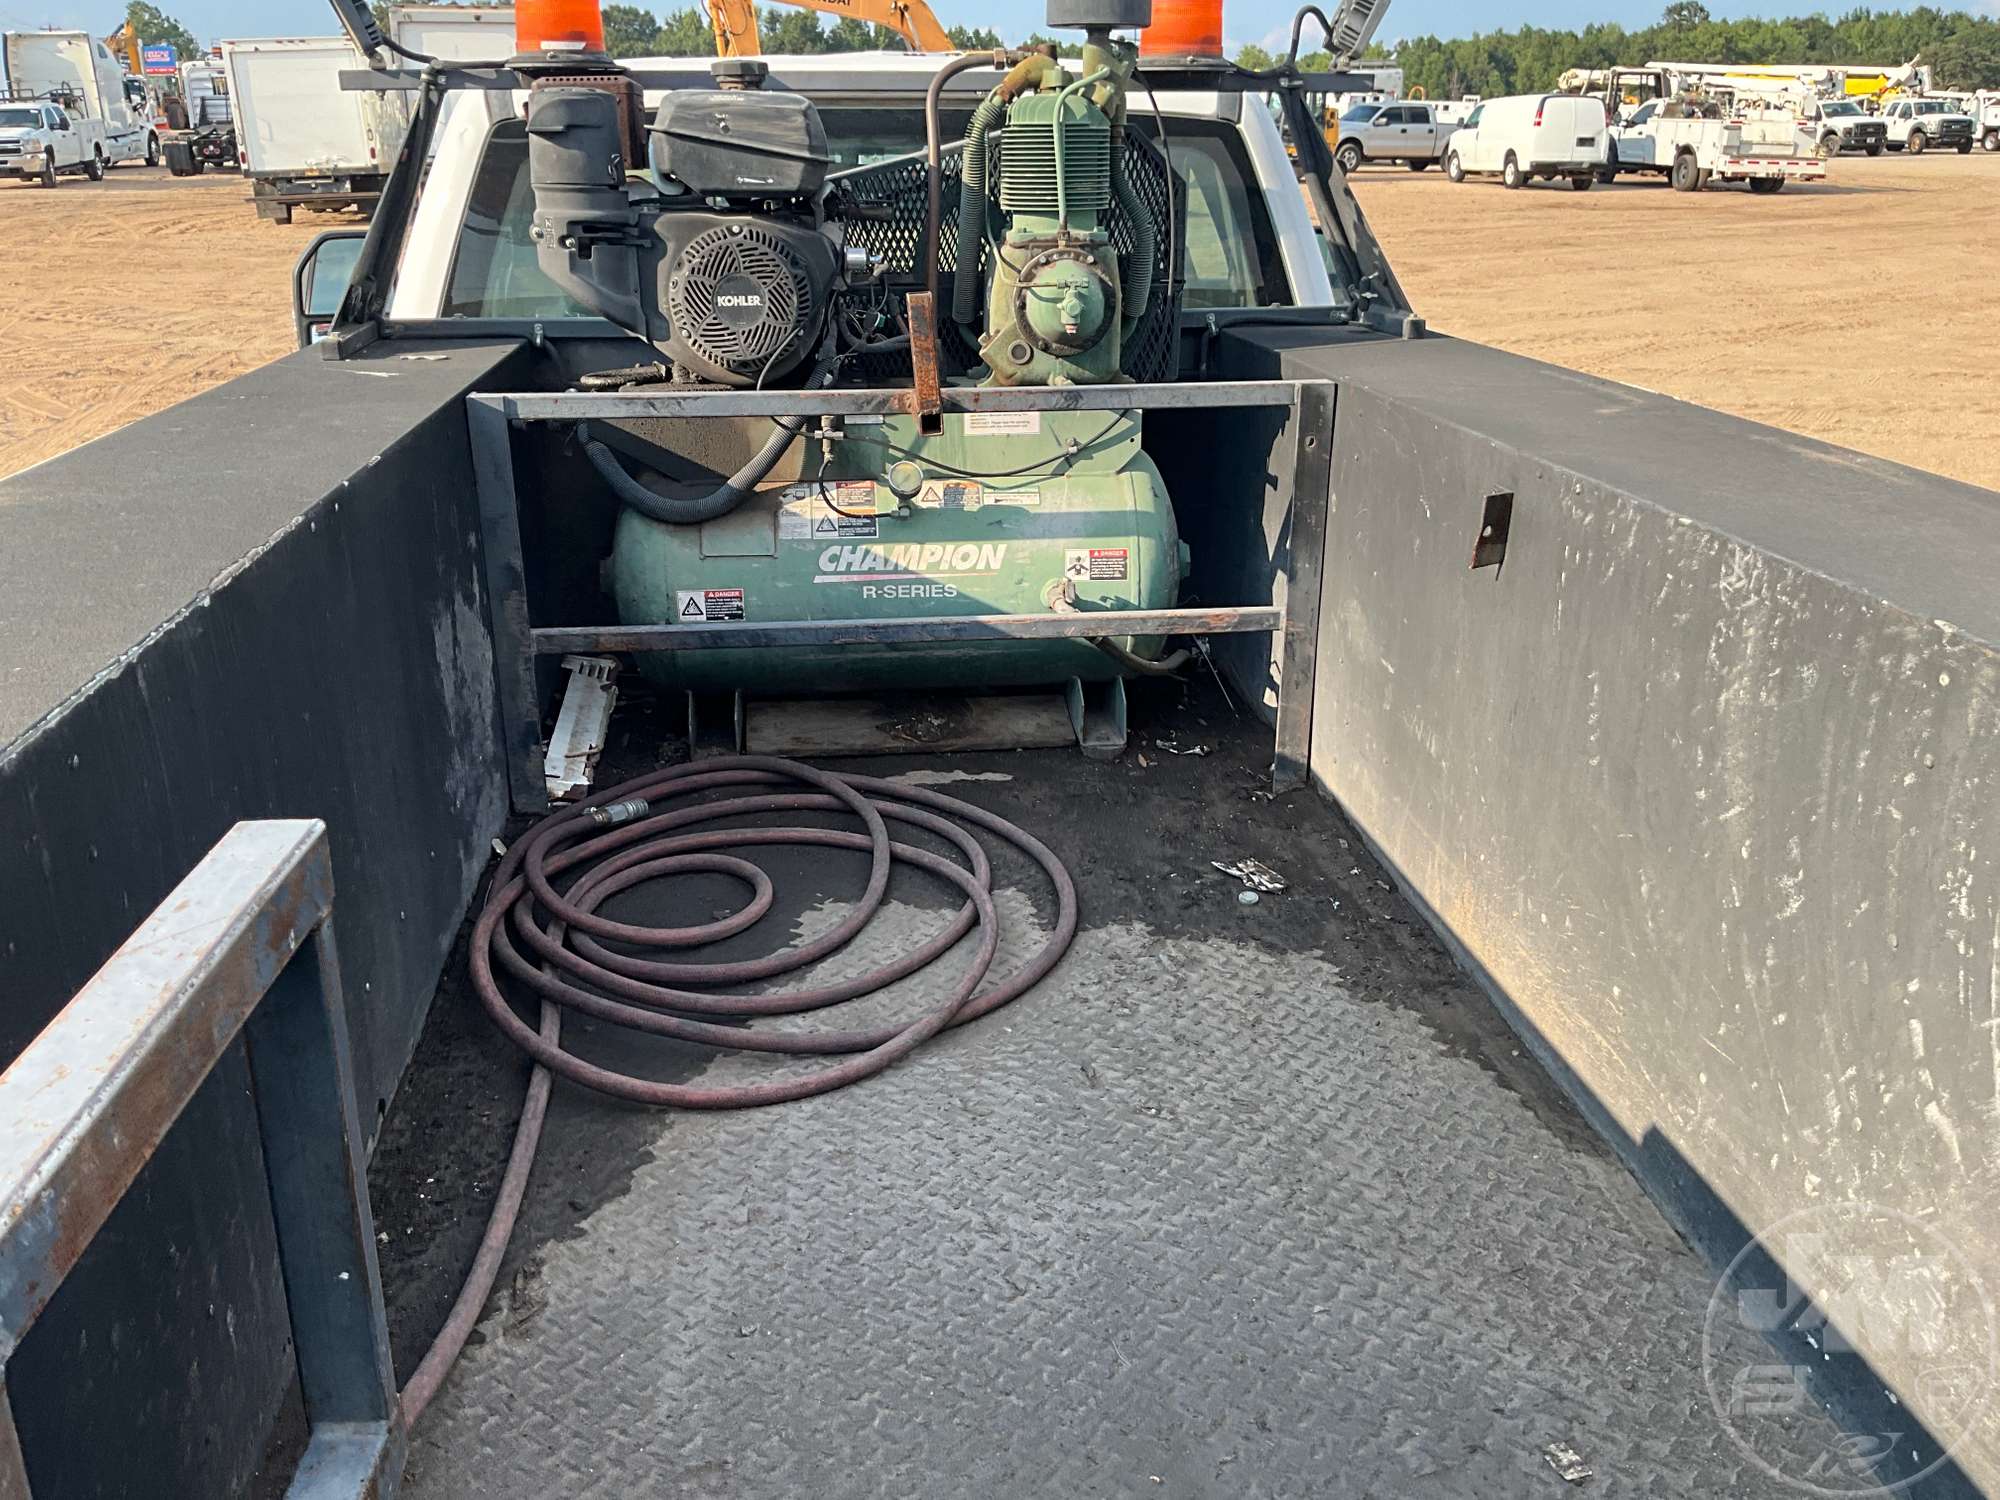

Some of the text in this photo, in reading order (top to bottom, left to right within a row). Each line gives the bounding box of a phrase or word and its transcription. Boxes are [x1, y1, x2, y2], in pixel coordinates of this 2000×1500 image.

[717, 295, 762, 307] KOHLER
[818, 543, 1008, 572] CHAMPION
[862, 584, 958, 599] R-SERIES
